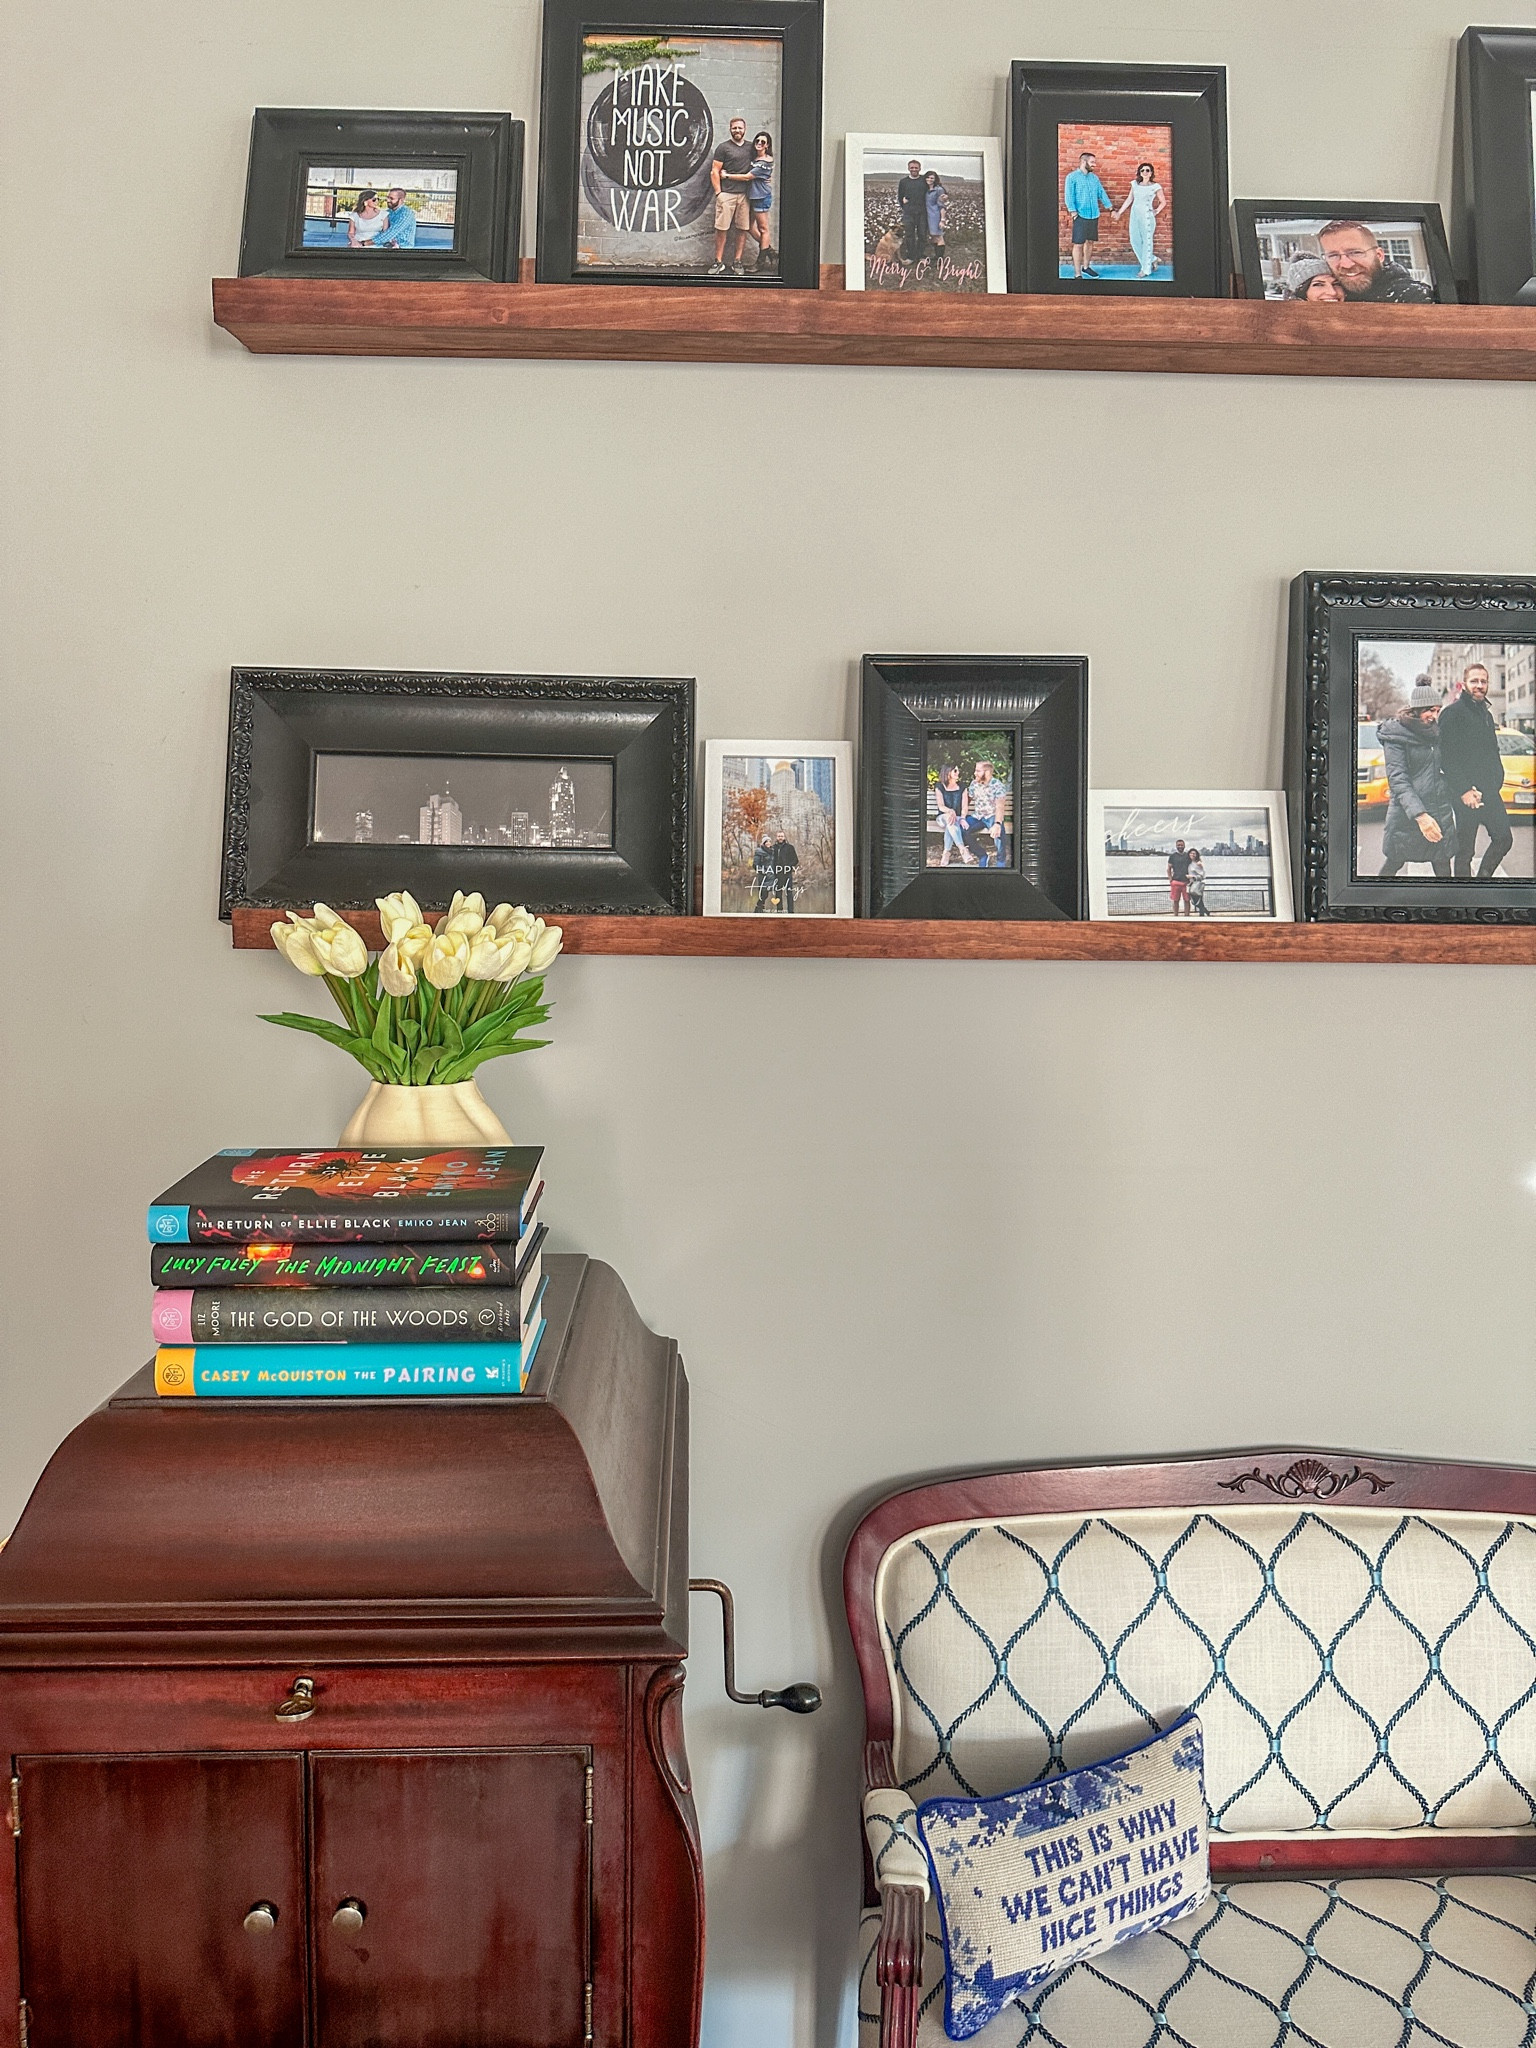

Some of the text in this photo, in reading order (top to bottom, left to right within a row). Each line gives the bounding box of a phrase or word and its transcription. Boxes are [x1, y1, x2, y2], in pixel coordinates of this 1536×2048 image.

[612, 63, 686, 107] MAKE
[610, 107, 689, 147] MUSIC
[623, 149, 671, 187] NOT
[610, 188, 682, 232] WAR
[869, 254, 912, 288] Merry
[936, 256, 986, 285] Bright
[756, 865, 799, 875] HAPPY
[744, 875, 808, 902] Holidays
[239, 1170, 265, 1184] THE
[252, 1152, 324, 1200] RETURN
[336, 1153, 387, 1187] ELLIE
[372, 1157, 425, 1198] BLACK
[426, 1161, 469, 1197] EMIKO
[474, 1150, 508, 1180] JEAN
[217, 1220, 273, 1230] RETURN
[298, 1219, 337, 1229] ELLIE
[344, 1218, 391, 1228] BLACK
[398, 1219, 434, 1227] EMIKO
[438, 1218, 468, 1227] JEAN
[161, 1256, 206, 1274] LUCY
[206, 1256, 263, 1276] FOLEY
[275, 1259, 311, 1276] THE
[314, 1255, 415, 1278] MIDNIGHT
[418, 1255, 483, 1276] FEAST
[197, 1313, 206, 1326] LIZ
[211, 1300, 221, 1337] MOORE
[230, 1309, 469, 1328] THE GOD OF THE WOODS
[201, 1366, 476, 1383] CASEY McQUISTON THE PAIRING
[1024, 1798, 1176, 1878] THIS IS WHY
[1001, 1824, 1200, 1924] WE CAN'T HAVE
[1040, 1870, 1183, 1953] NICE THINGS
